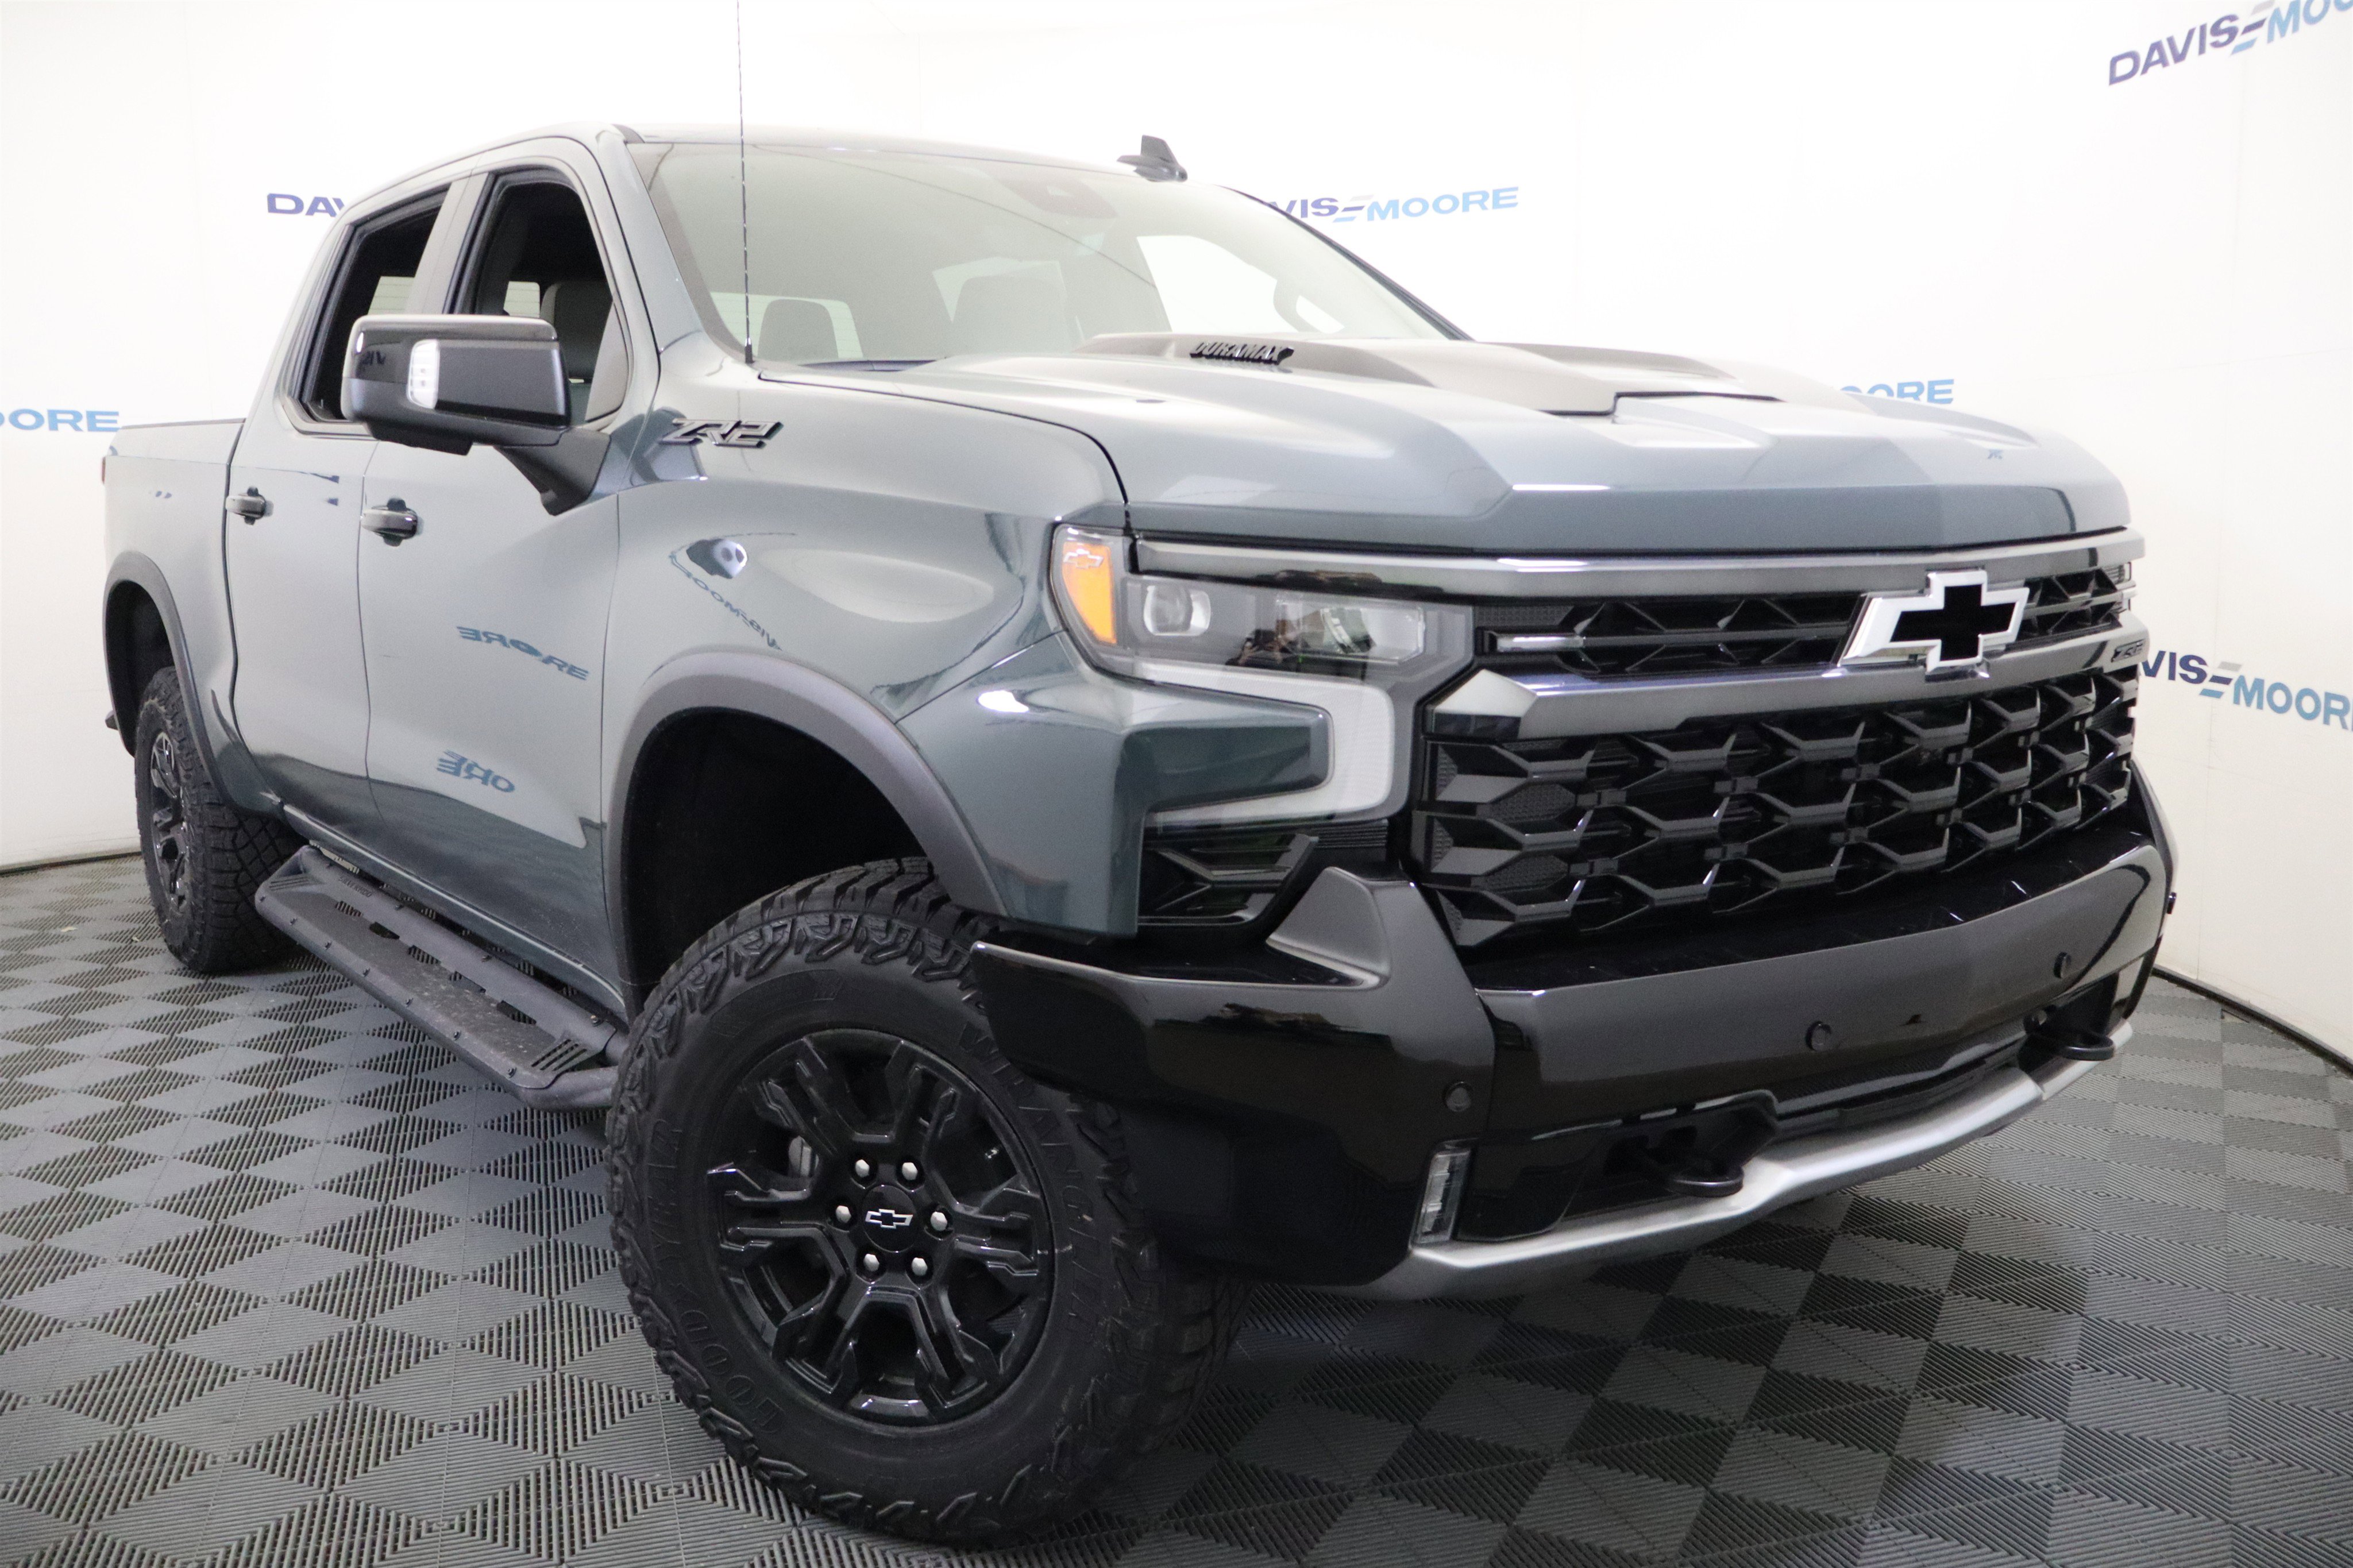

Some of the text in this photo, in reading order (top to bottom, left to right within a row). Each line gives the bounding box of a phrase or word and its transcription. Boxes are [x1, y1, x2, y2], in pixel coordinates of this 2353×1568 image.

[2109, 14, 2239, 86] DAVIS
[1367, 187, 1519, 221] MOORE
[1190, 342, 1294, 365] DURAMAX
[0, 408, 119, 432] ORE
[659, 418, 784, 449] ZR2
[2232, 675, 2353, 731] MOOR
